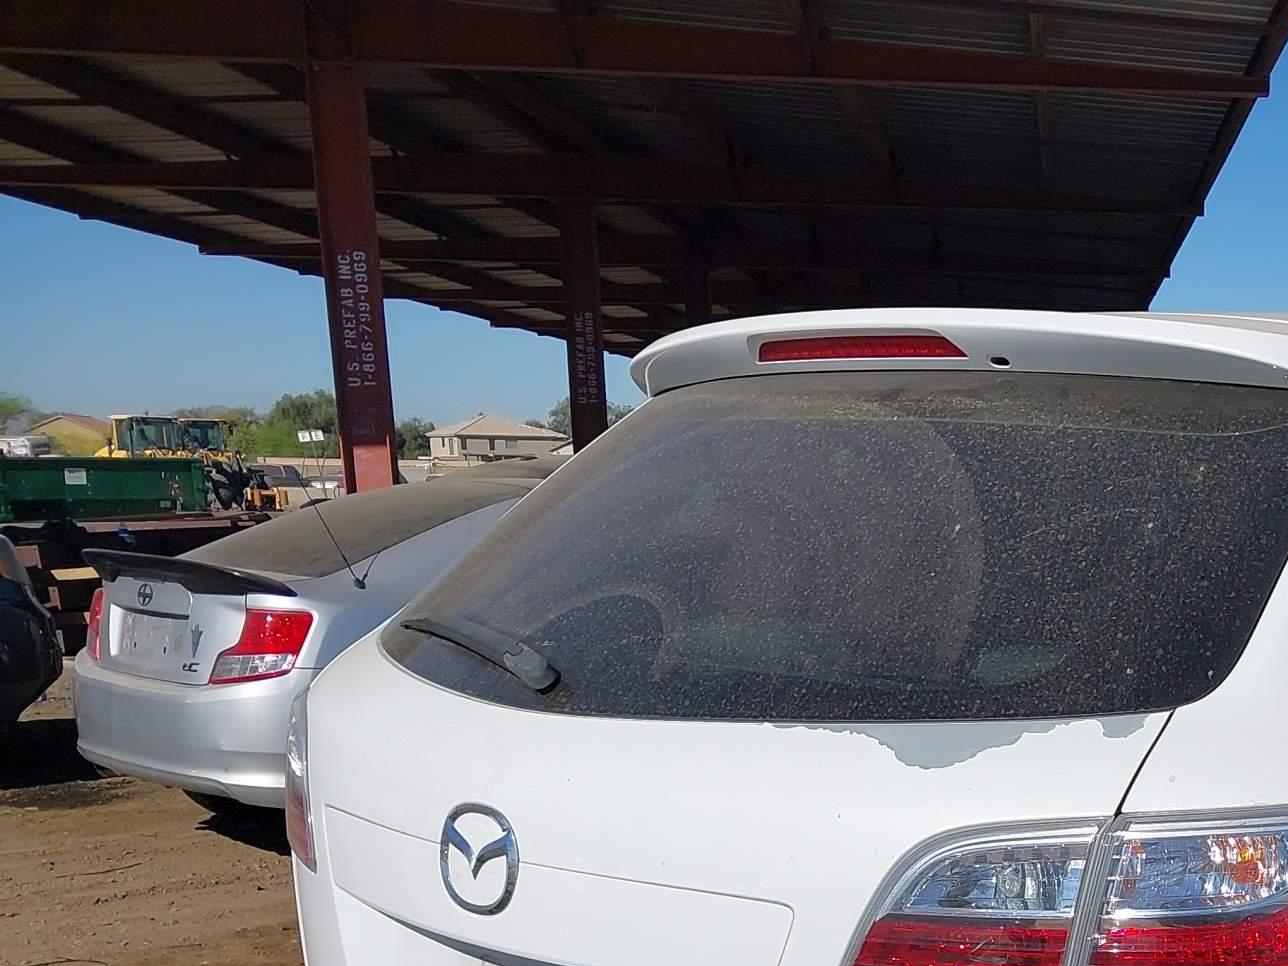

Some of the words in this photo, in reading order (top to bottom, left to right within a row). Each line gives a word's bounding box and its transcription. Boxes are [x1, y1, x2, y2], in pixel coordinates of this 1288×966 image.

[337, 249, 352, 280] INC.
[340, 288, 358, 349] PREFAB
[353, 249, 375, 386] 1-866-799-0969
[347, 357, 361, 387] U.S.
